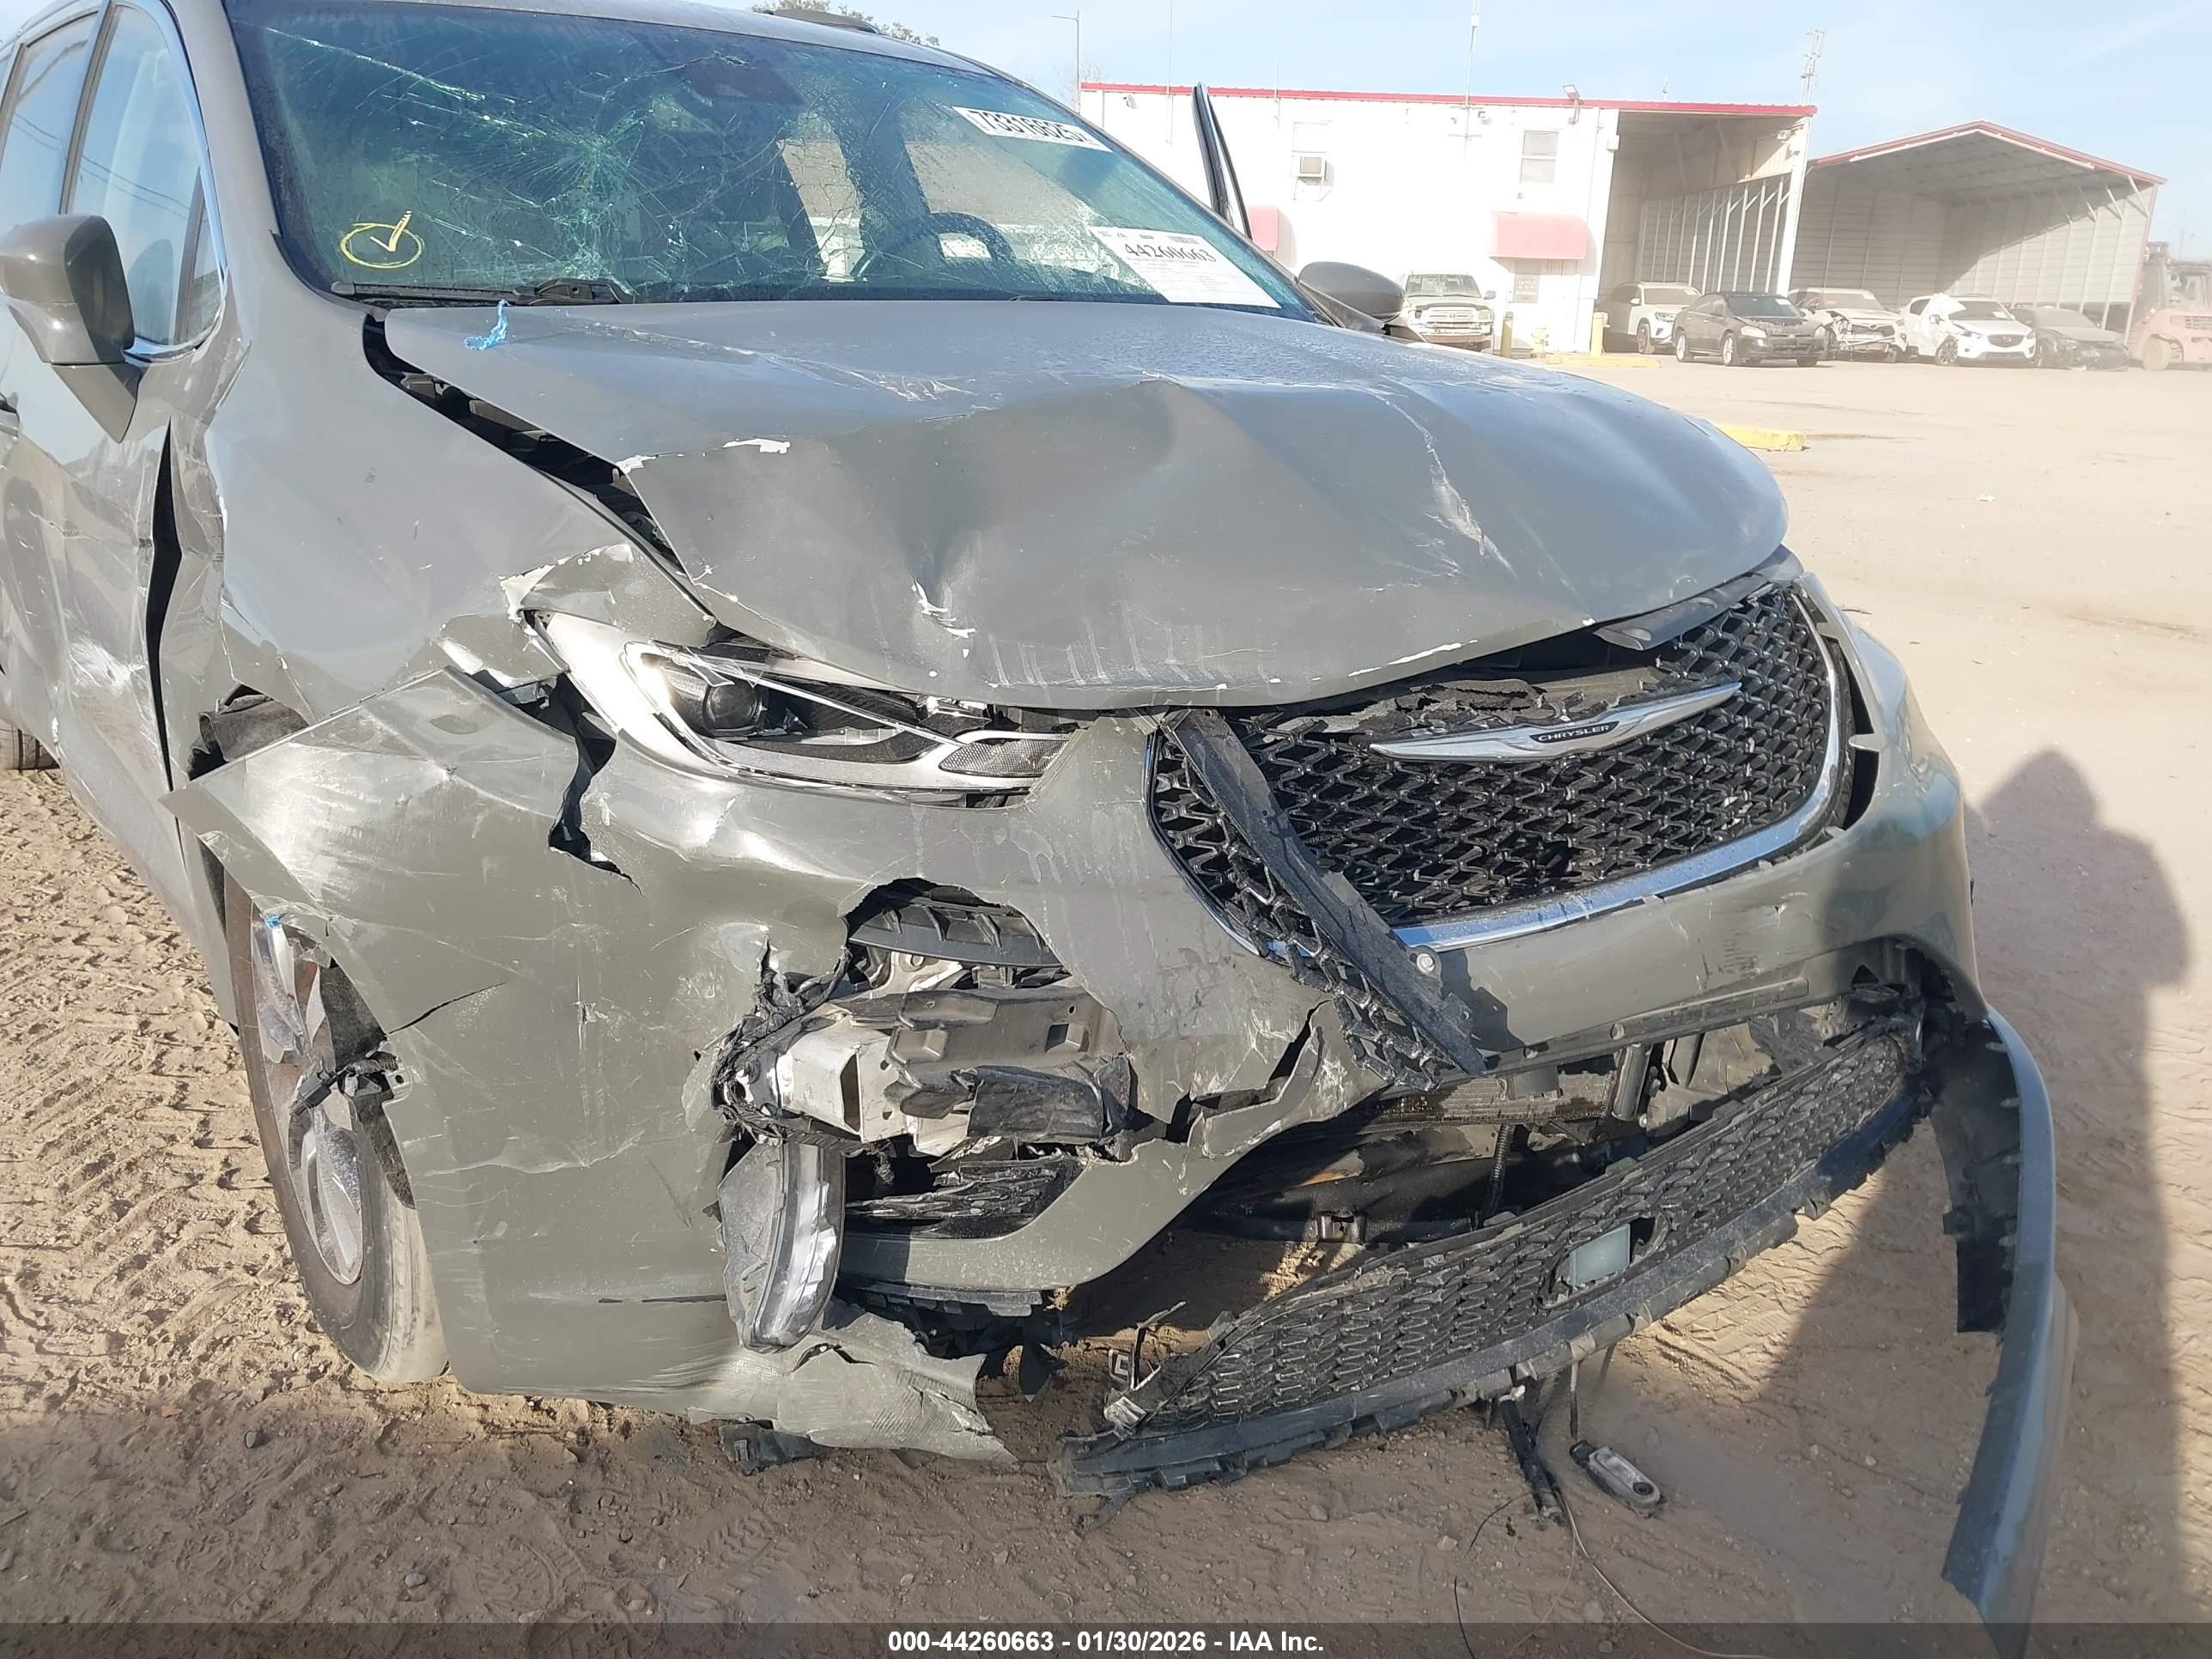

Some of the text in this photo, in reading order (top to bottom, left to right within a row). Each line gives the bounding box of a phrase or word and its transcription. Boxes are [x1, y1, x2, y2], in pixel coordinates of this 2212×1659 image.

[968, 109, 1085, 143] 73316625
[1124, 243, 1217, 263] 44260663
[1537, 725, 1610, 742] CHRYSLER
